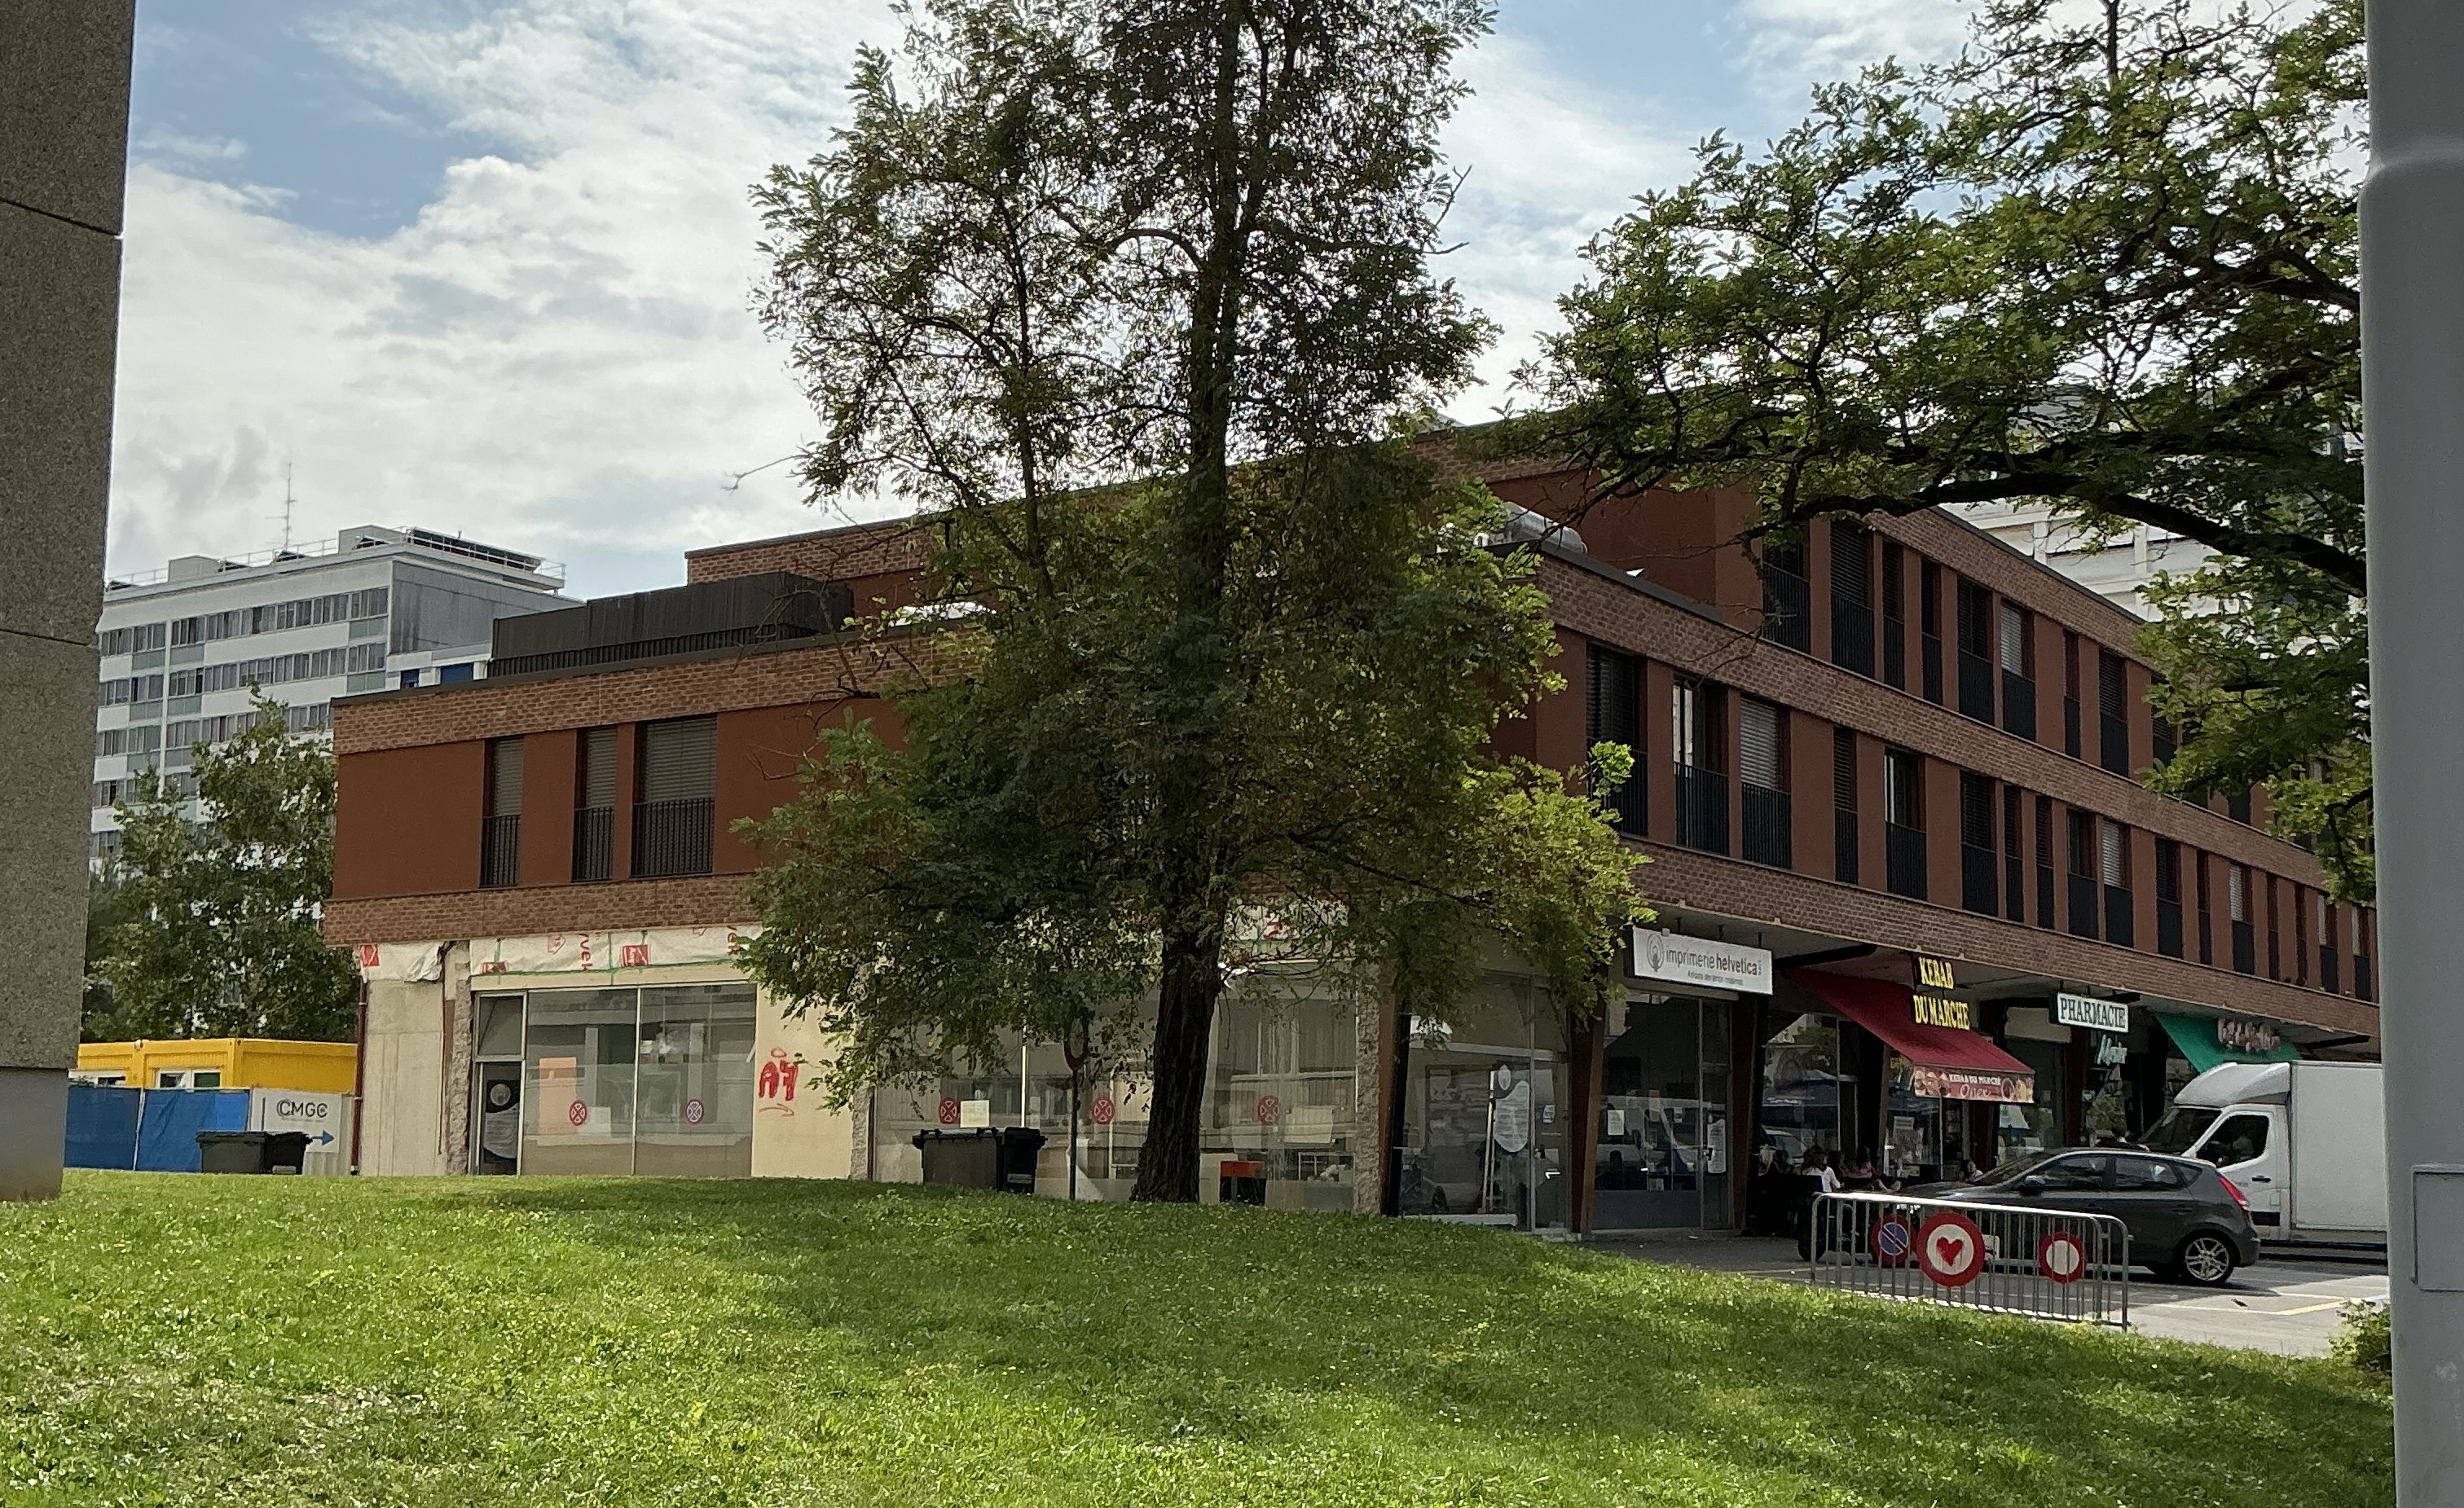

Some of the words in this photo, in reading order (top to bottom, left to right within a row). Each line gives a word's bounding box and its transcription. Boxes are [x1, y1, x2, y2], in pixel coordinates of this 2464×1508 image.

[1665, 945, 1715, 969] imprimerie
[1716, 952, 1758, 976] helvetica
[1918, 956, 1954, 990] KEBAB
[1913, 995, 1929, 1025] DU
[1929, 997, 1970, 1031] MARCHE
[2060, 998, 2126, 1029] PHARMACIE
[276, 1098, 328, 1119] CMGC
